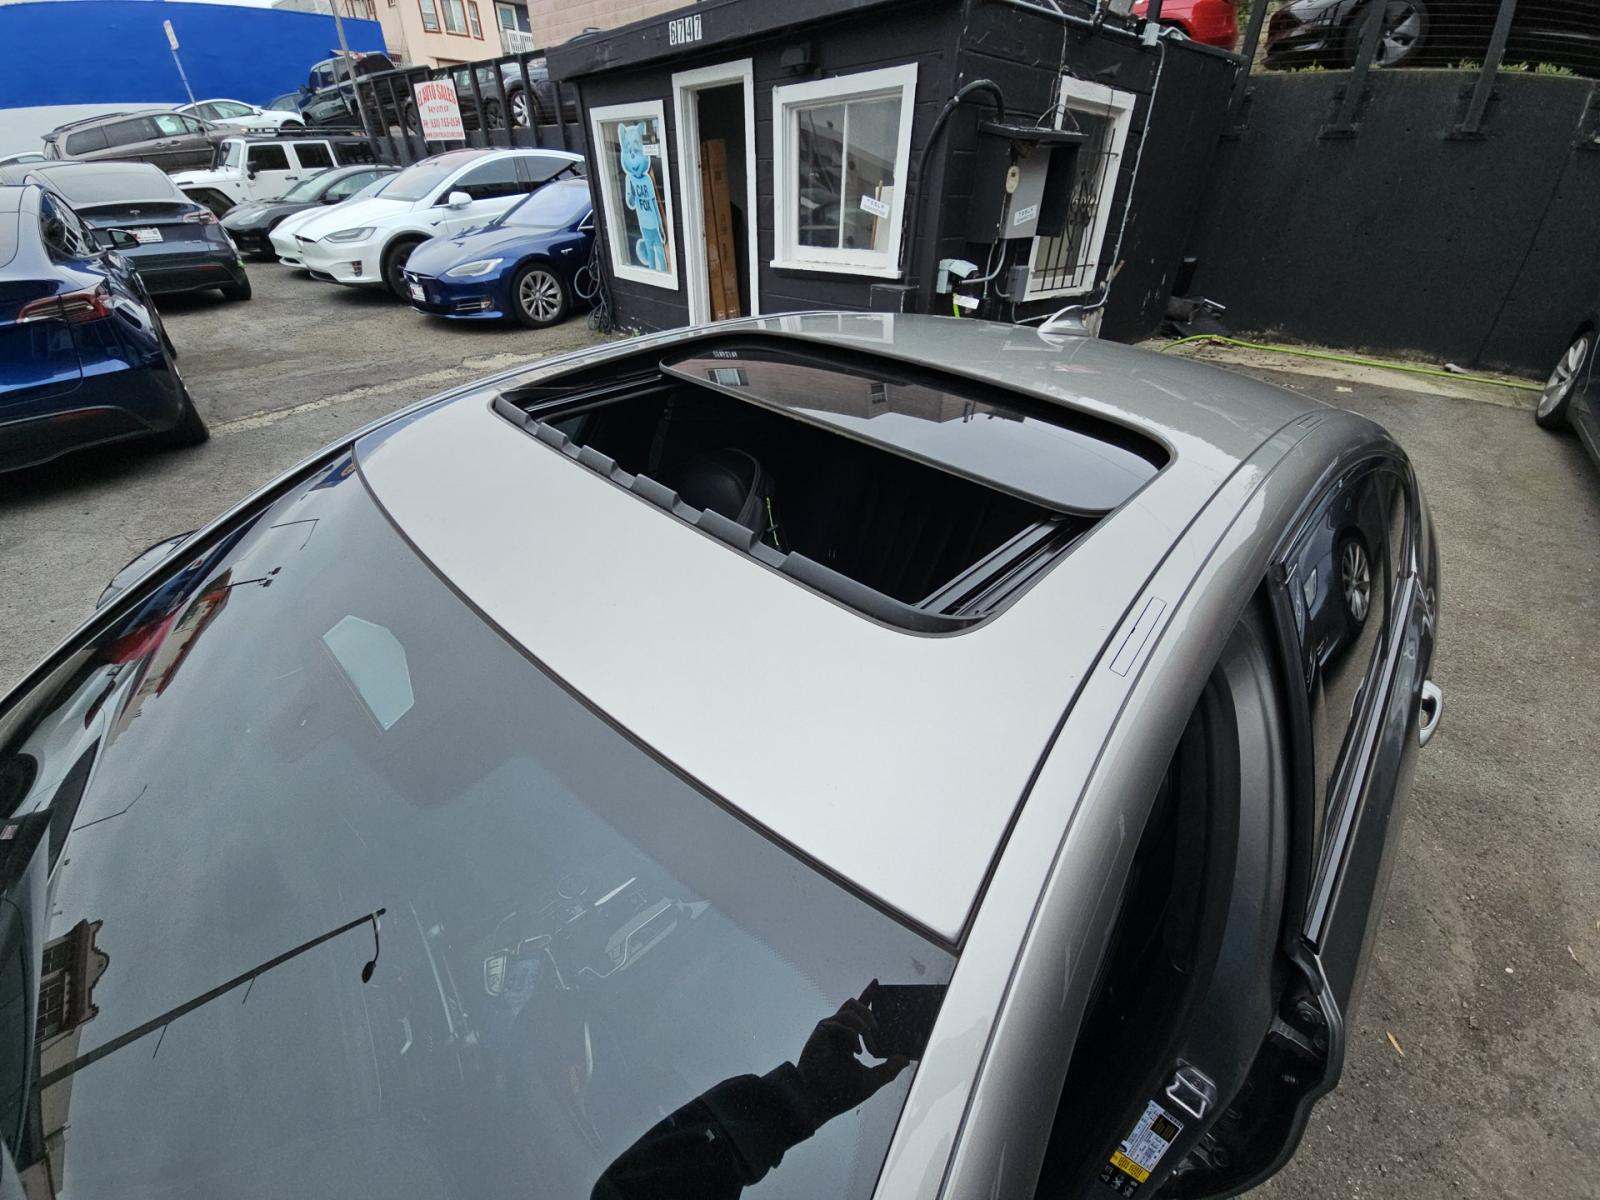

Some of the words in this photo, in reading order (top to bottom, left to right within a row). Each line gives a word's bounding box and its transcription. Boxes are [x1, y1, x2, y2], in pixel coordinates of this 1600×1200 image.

[670, 16, 701, 44] 6747
[423, 83, 437, 103] AUTO
[438, 84, 457, 105] SALES
[636, 185, 649, 198] CAR
[639, 199, 652, 212] FOX
